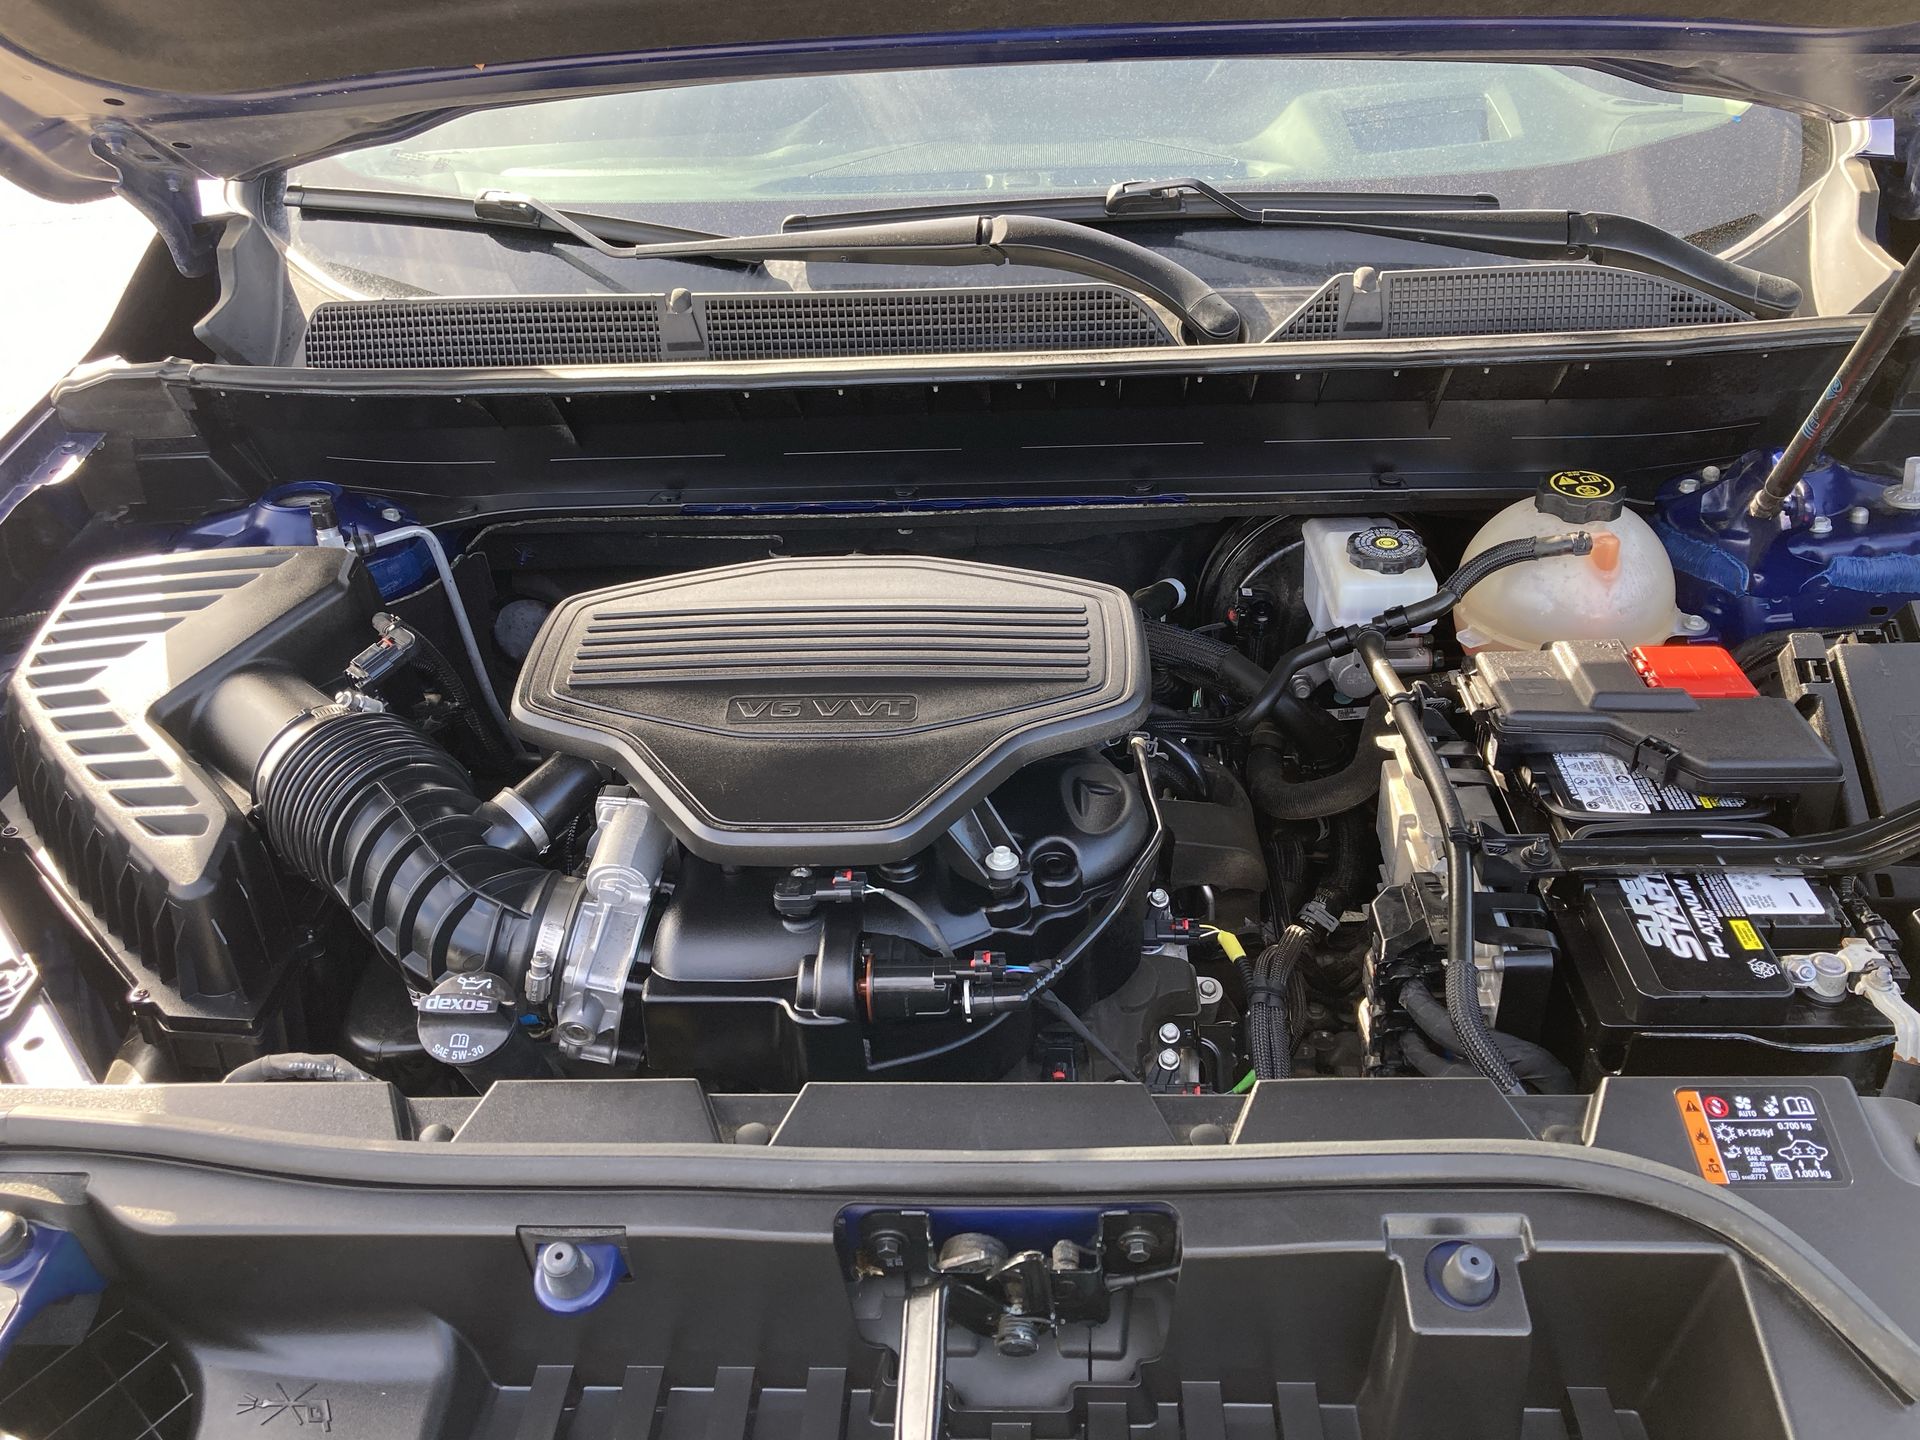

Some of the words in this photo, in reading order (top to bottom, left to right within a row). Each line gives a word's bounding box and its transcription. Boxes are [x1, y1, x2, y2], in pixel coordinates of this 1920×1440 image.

[736, 700, 801, 717] V6
[812, 699, 910, 716] VVT
[1618, 879, 1673, 949] SUPE
[1673, 879, 1730, 958] PLATINUM
[425, 995, 489, 1011] dexos
[432, 1043, 449, 1058] SAE
[451, 1045, 484, 1060] 5W-30
[1777, 1122, 1800, 1130] 0.700
[1800, 1122, 1813, 1131] kg
[1744, 1147, 1762, 1156] PAG
[1795, 1169, 1819, 1178] 1.000
[1819, 1169, 1832, 1179] kg
